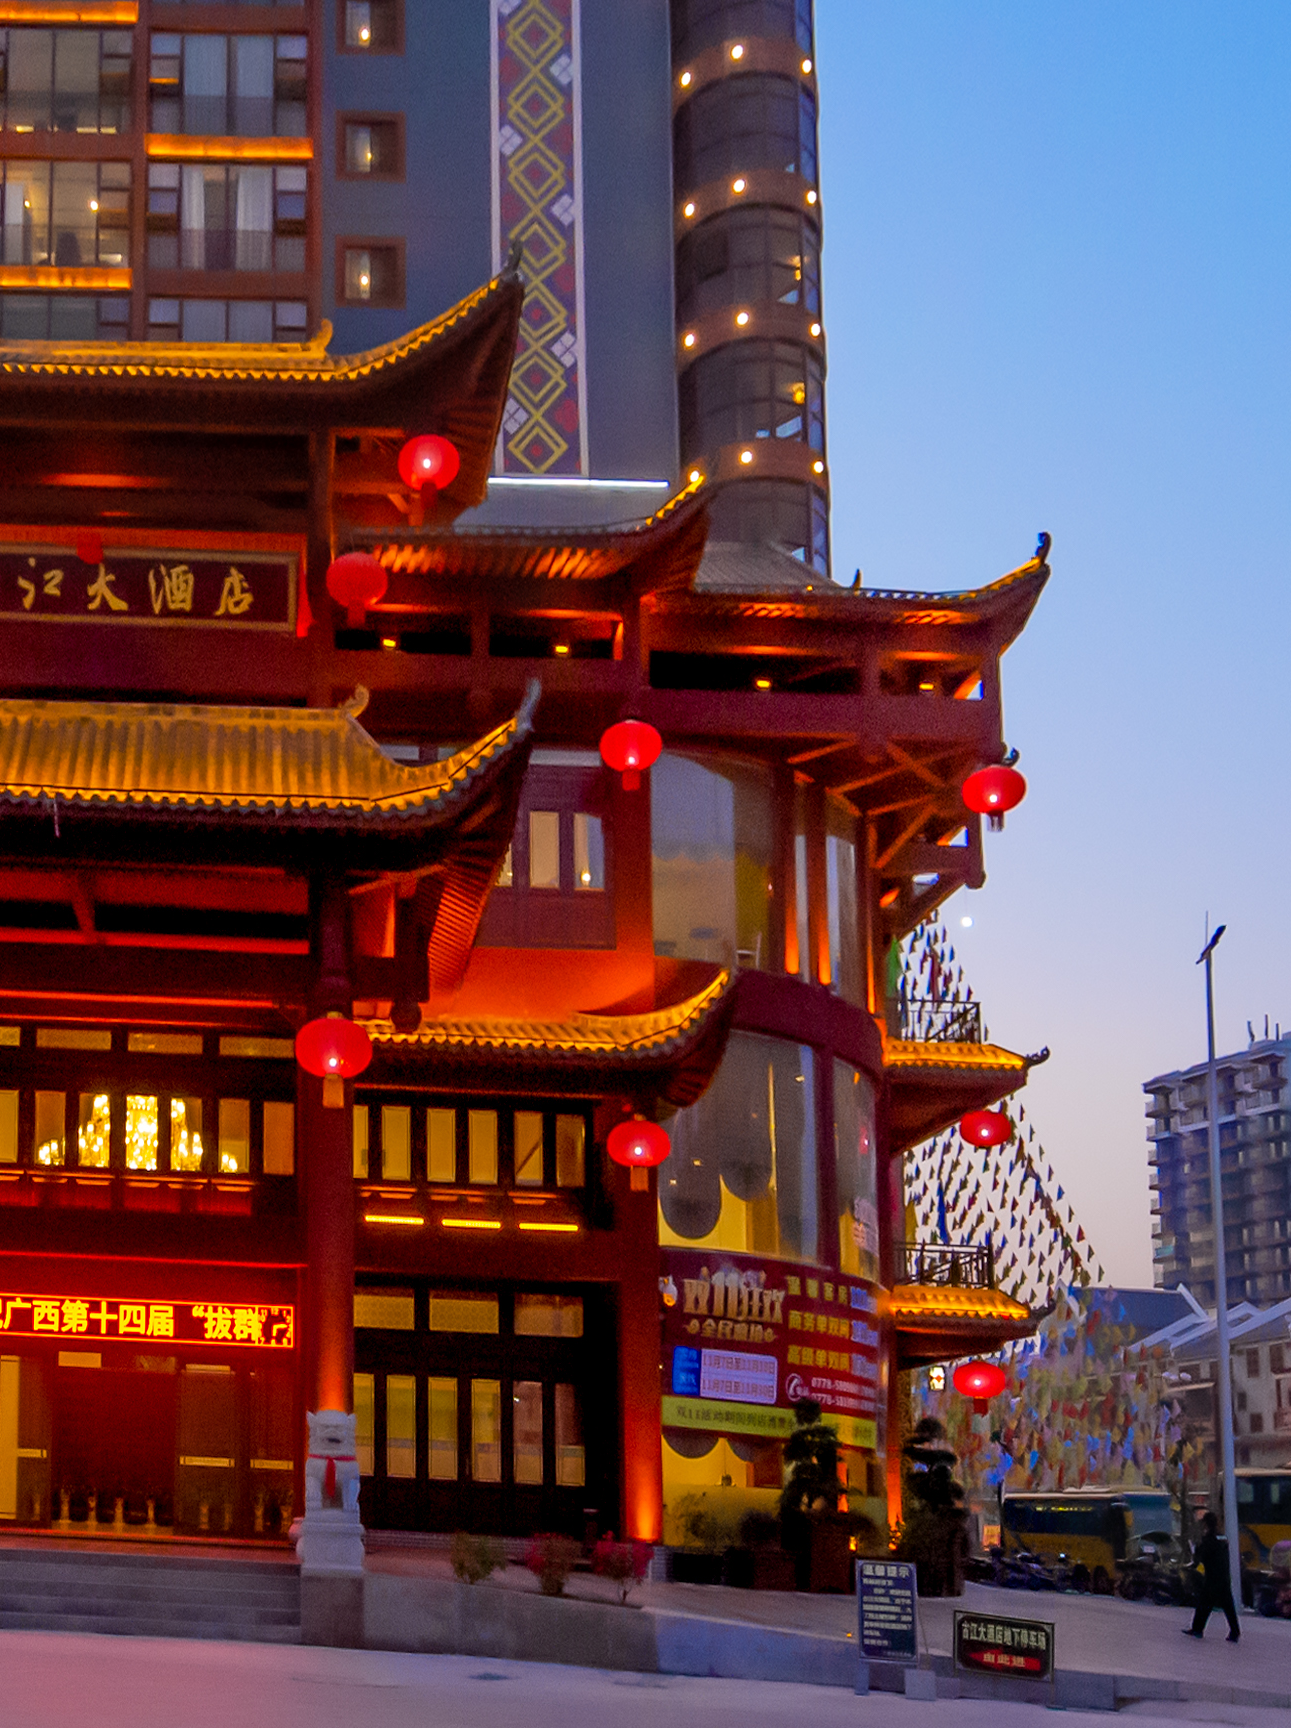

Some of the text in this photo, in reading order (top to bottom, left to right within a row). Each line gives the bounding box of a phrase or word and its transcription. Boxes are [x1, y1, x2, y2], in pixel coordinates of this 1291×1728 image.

[961, 1620, 1046, 1650] 古江大酒店地下停车场
